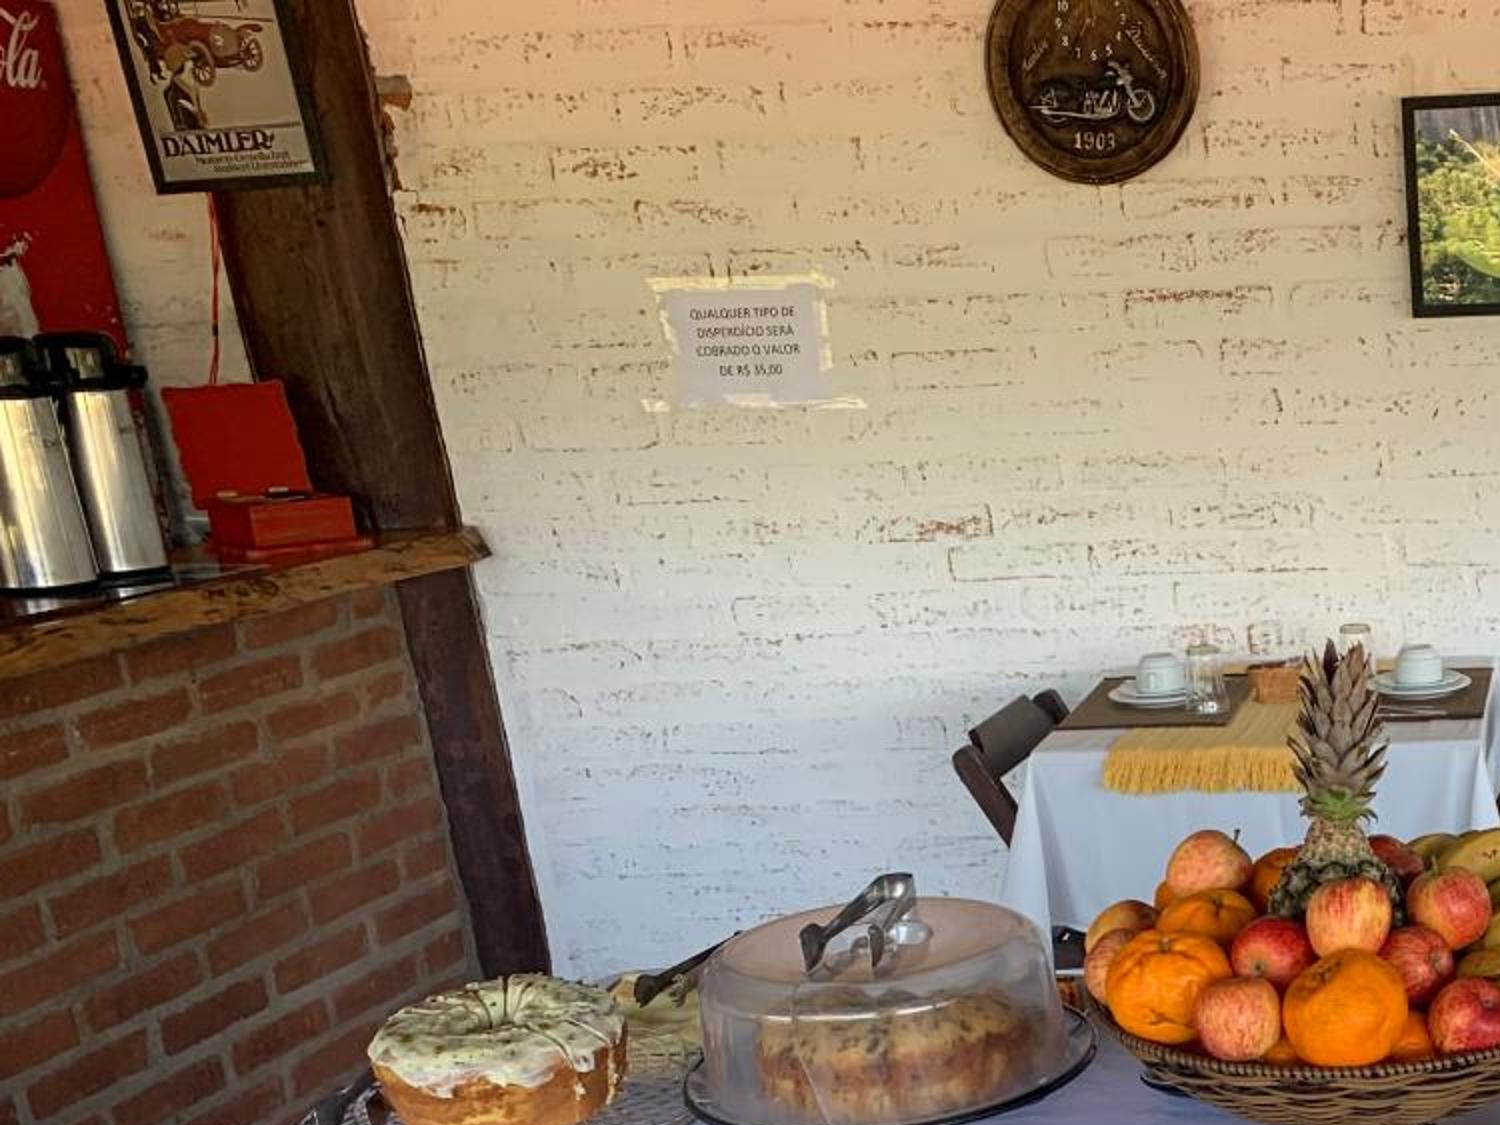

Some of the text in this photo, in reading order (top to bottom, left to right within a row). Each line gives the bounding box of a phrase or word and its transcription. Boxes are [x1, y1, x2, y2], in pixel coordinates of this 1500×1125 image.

[1073, 131, 1116, 151] 1903
[689, 306, 795, 320] QUALQUER TIPO DE
[696, 343, 801, 357] COBRADO O VALOR
[719, 365, 733, 376] DE
[737, 364, 751, 377] R$
